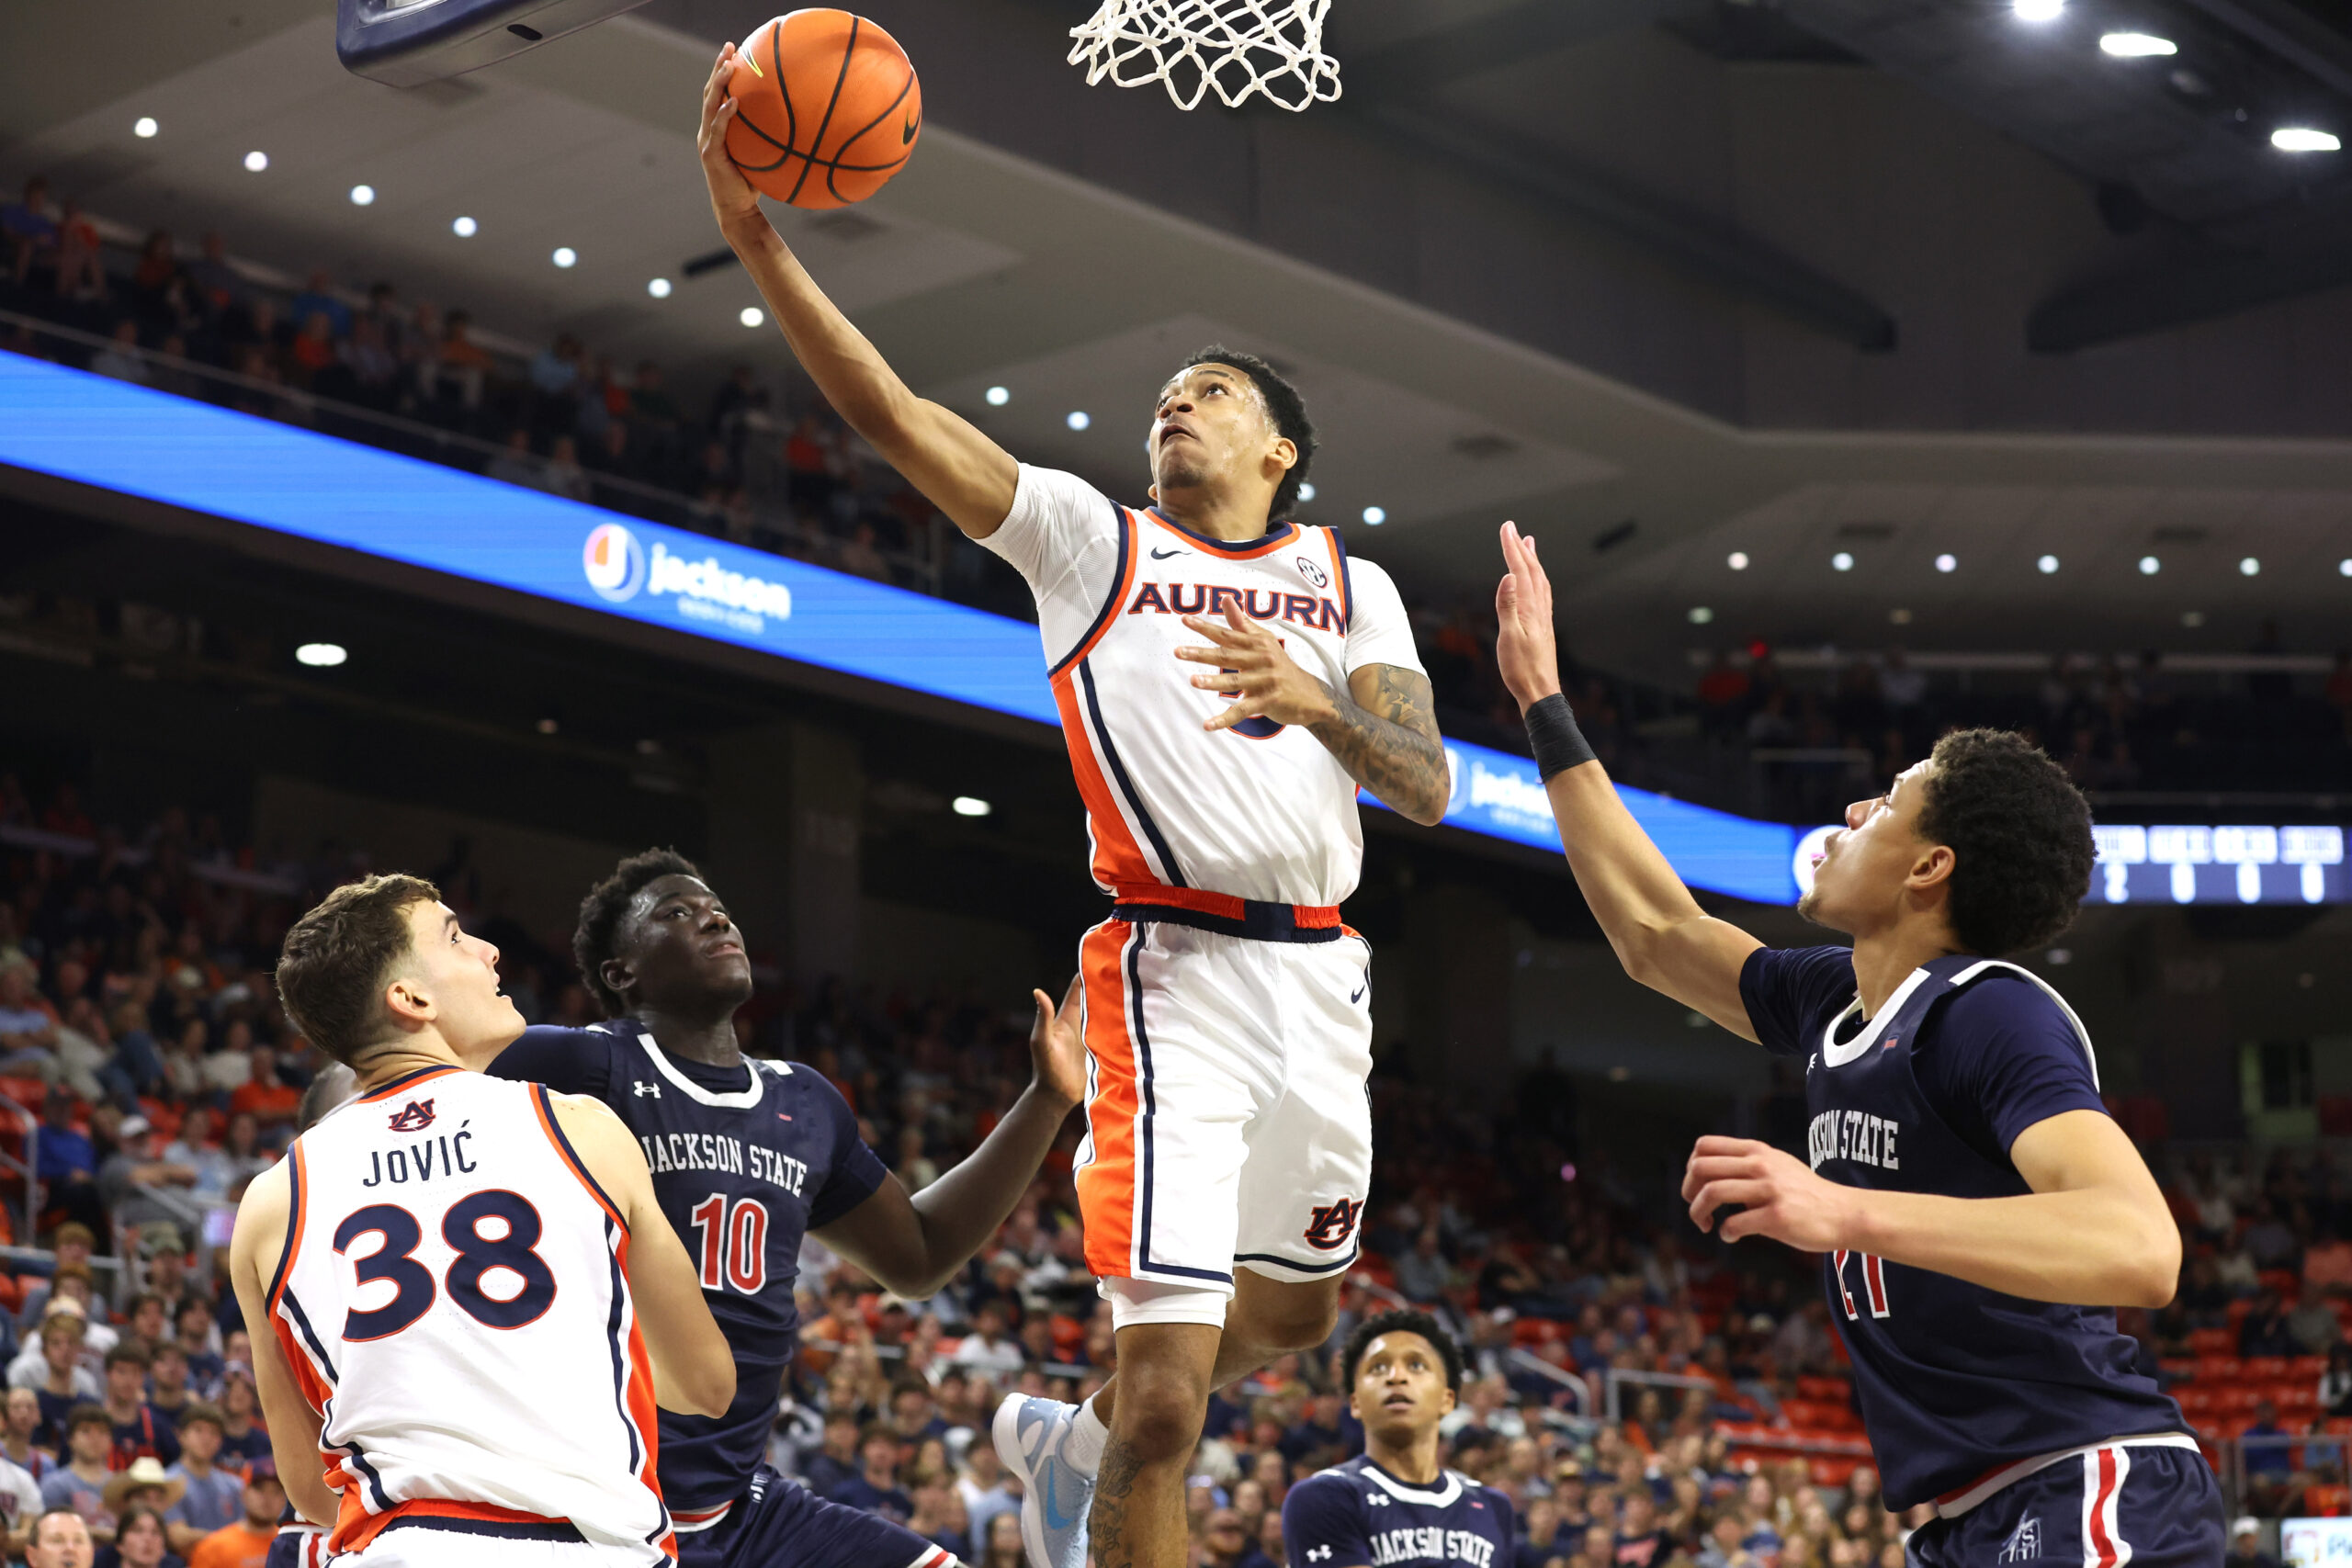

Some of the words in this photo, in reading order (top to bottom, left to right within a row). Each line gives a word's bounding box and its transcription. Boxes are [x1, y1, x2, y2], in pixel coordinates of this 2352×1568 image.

[1127, 581, 1346, 638] AUBURN
[363, 1119, 477, 1187] JOVIĆ
[641, 1133, 743, 1175] JACKSON
[750, 1144, 808, 1198] STATE
[1840, 1110, 1899, 1170] STATE
[333, 1188, 558, 1343] 38
[691, 1192, 769, 1295] 10
[1369, 1526, 1444, 1567] JACKSON
[1446, 1529, 1495, 1568] STATE
